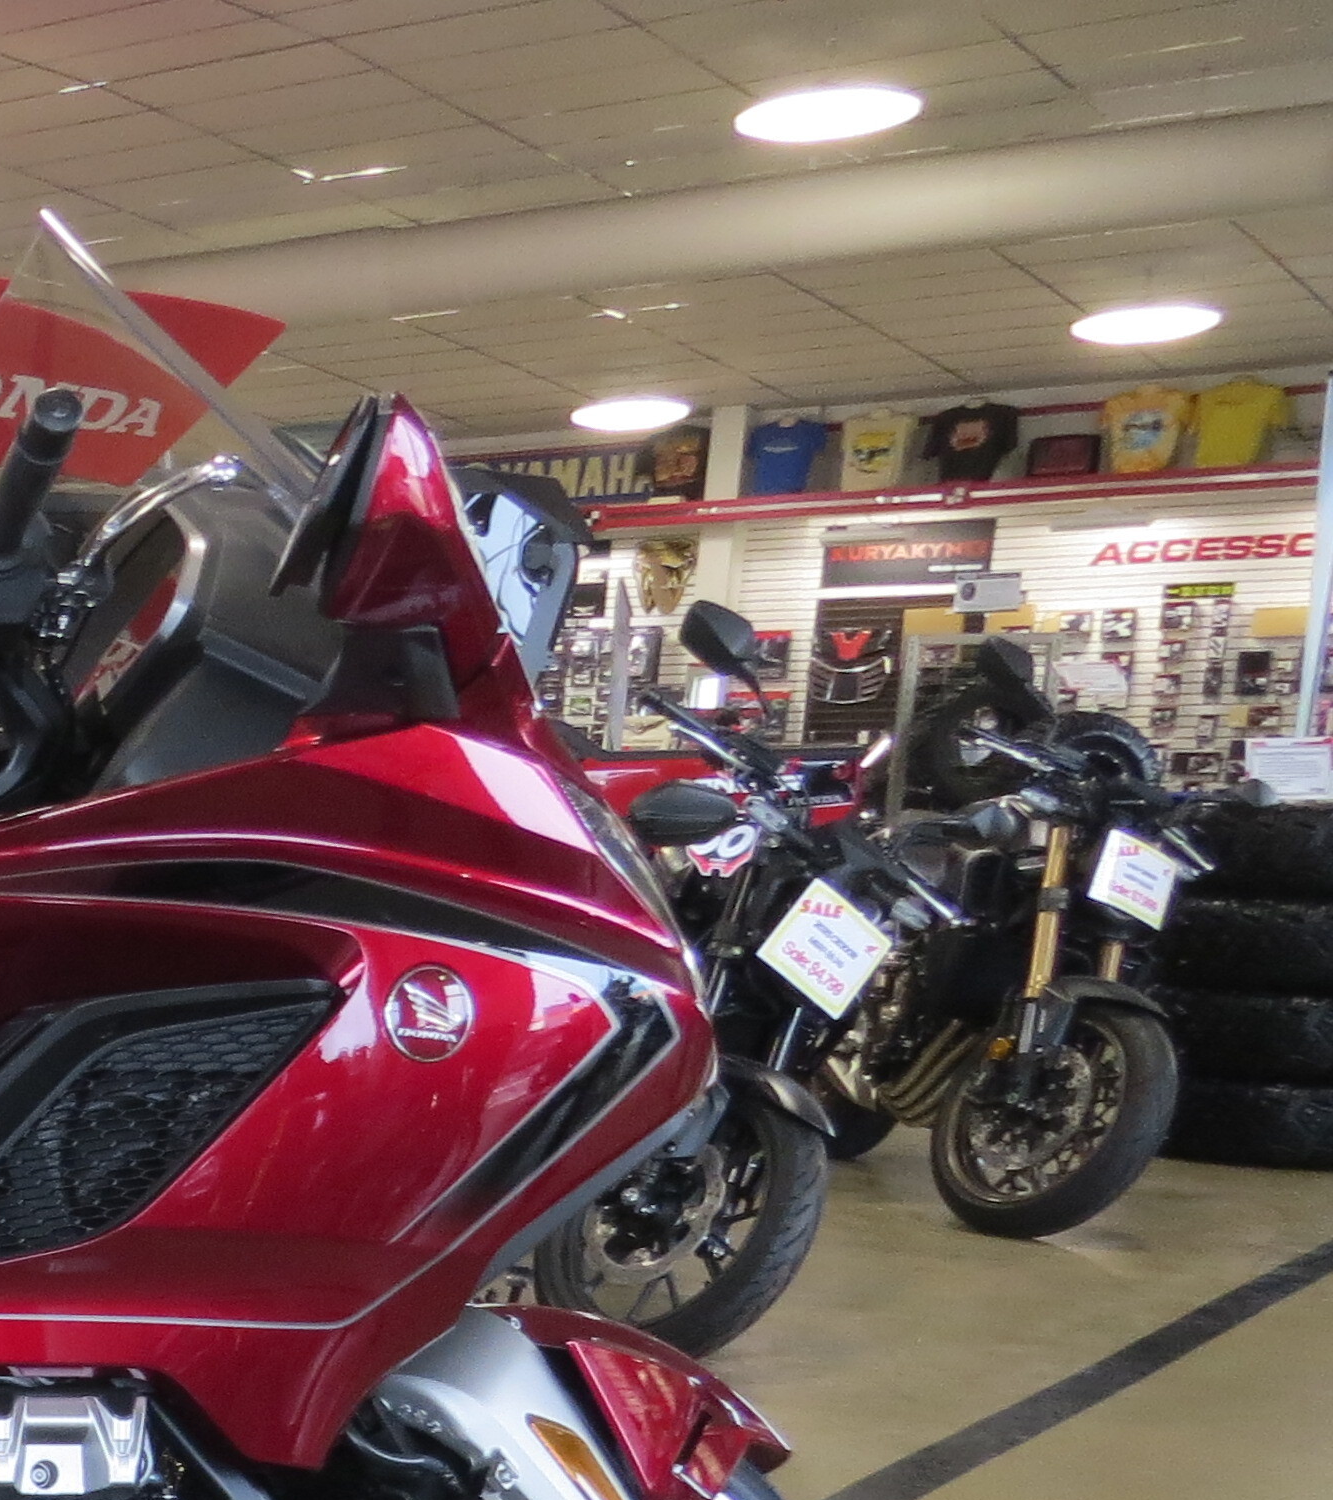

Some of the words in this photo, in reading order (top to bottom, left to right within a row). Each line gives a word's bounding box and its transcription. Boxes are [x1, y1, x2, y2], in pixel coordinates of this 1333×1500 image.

[499, 452, 653, 498] MAH
[799, 899, 845, 919] SALE
[397, 1027, 459, 1043] HONDA
